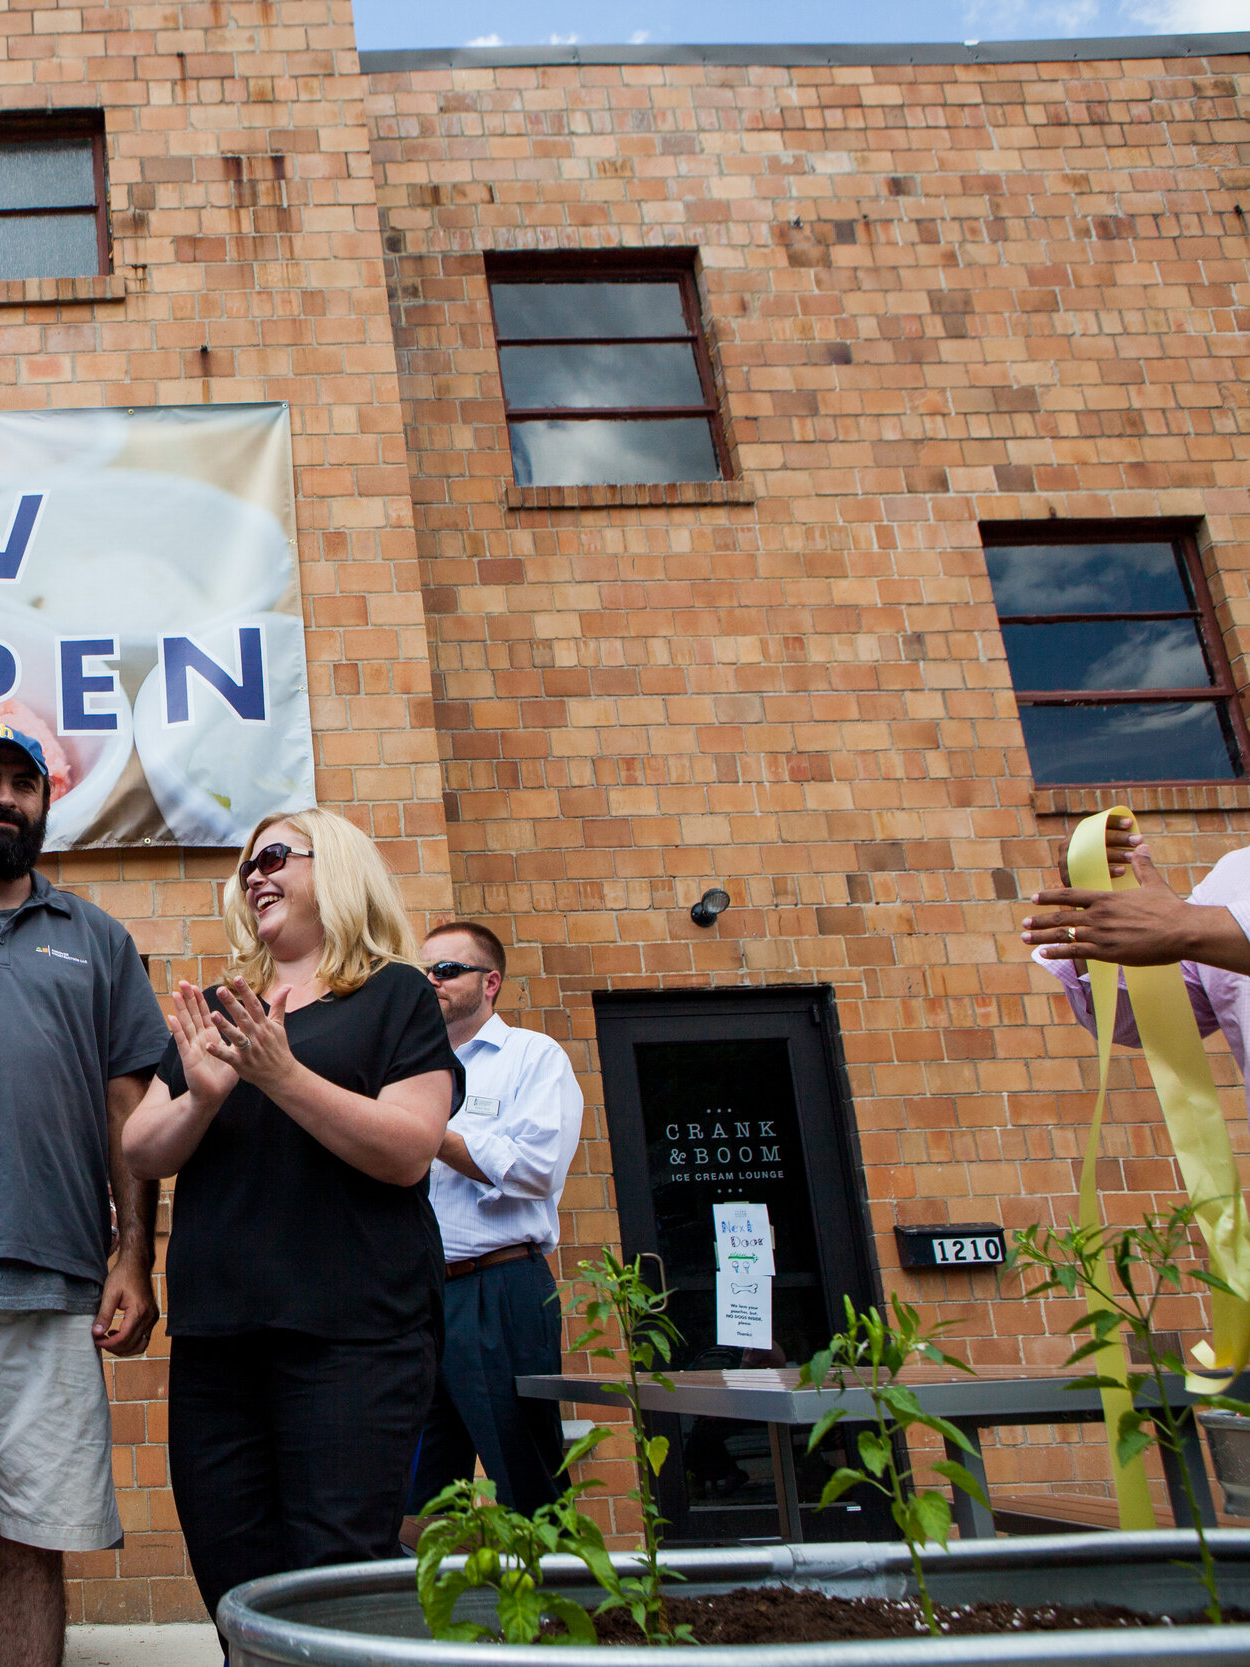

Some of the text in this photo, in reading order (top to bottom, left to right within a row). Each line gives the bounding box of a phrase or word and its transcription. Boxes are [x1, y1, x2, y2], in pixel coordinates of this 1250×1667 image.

[665, 1121, 777, 1140] CRANK
[671, 1170, 784, 1182] ICE CREAM LOUNGE
[721, 1220, 753, 1233] Next
[730, 1236, 765, 1247] Door
[937, 1238, 1000, 1262] 1210
